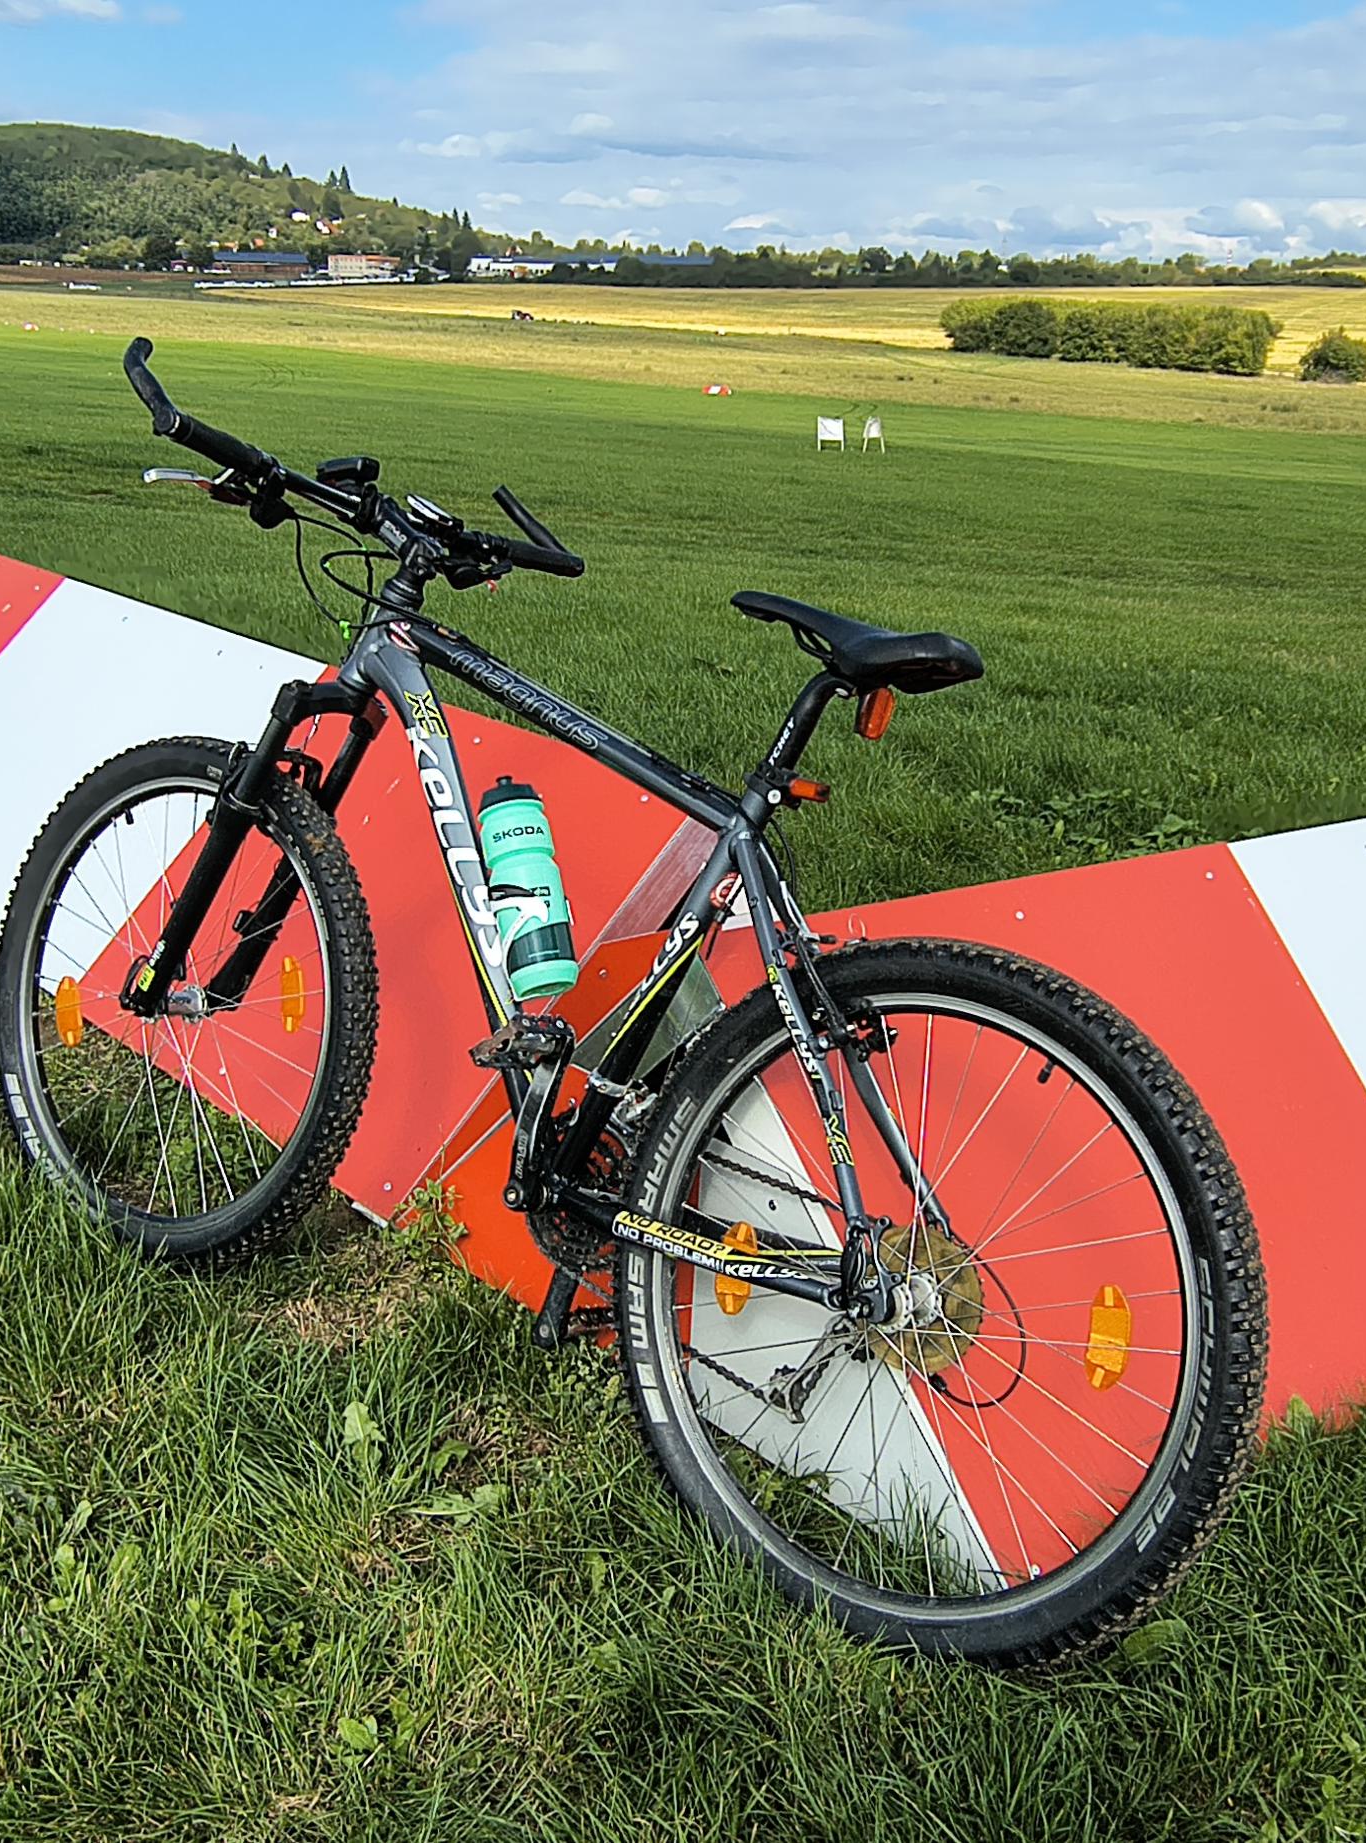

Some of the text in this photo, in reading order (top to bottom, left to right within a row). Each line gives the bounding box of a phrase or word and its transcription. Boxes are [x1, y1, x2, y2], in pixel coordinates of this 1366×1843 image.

[638, 1097, 697, 1214] SMAR
[617, 1224, 639, 1240] NO
[622, 1213, 726, 1254] NO ROAD?
[1135, 1256, 1215, 1553] SCHWALBE
